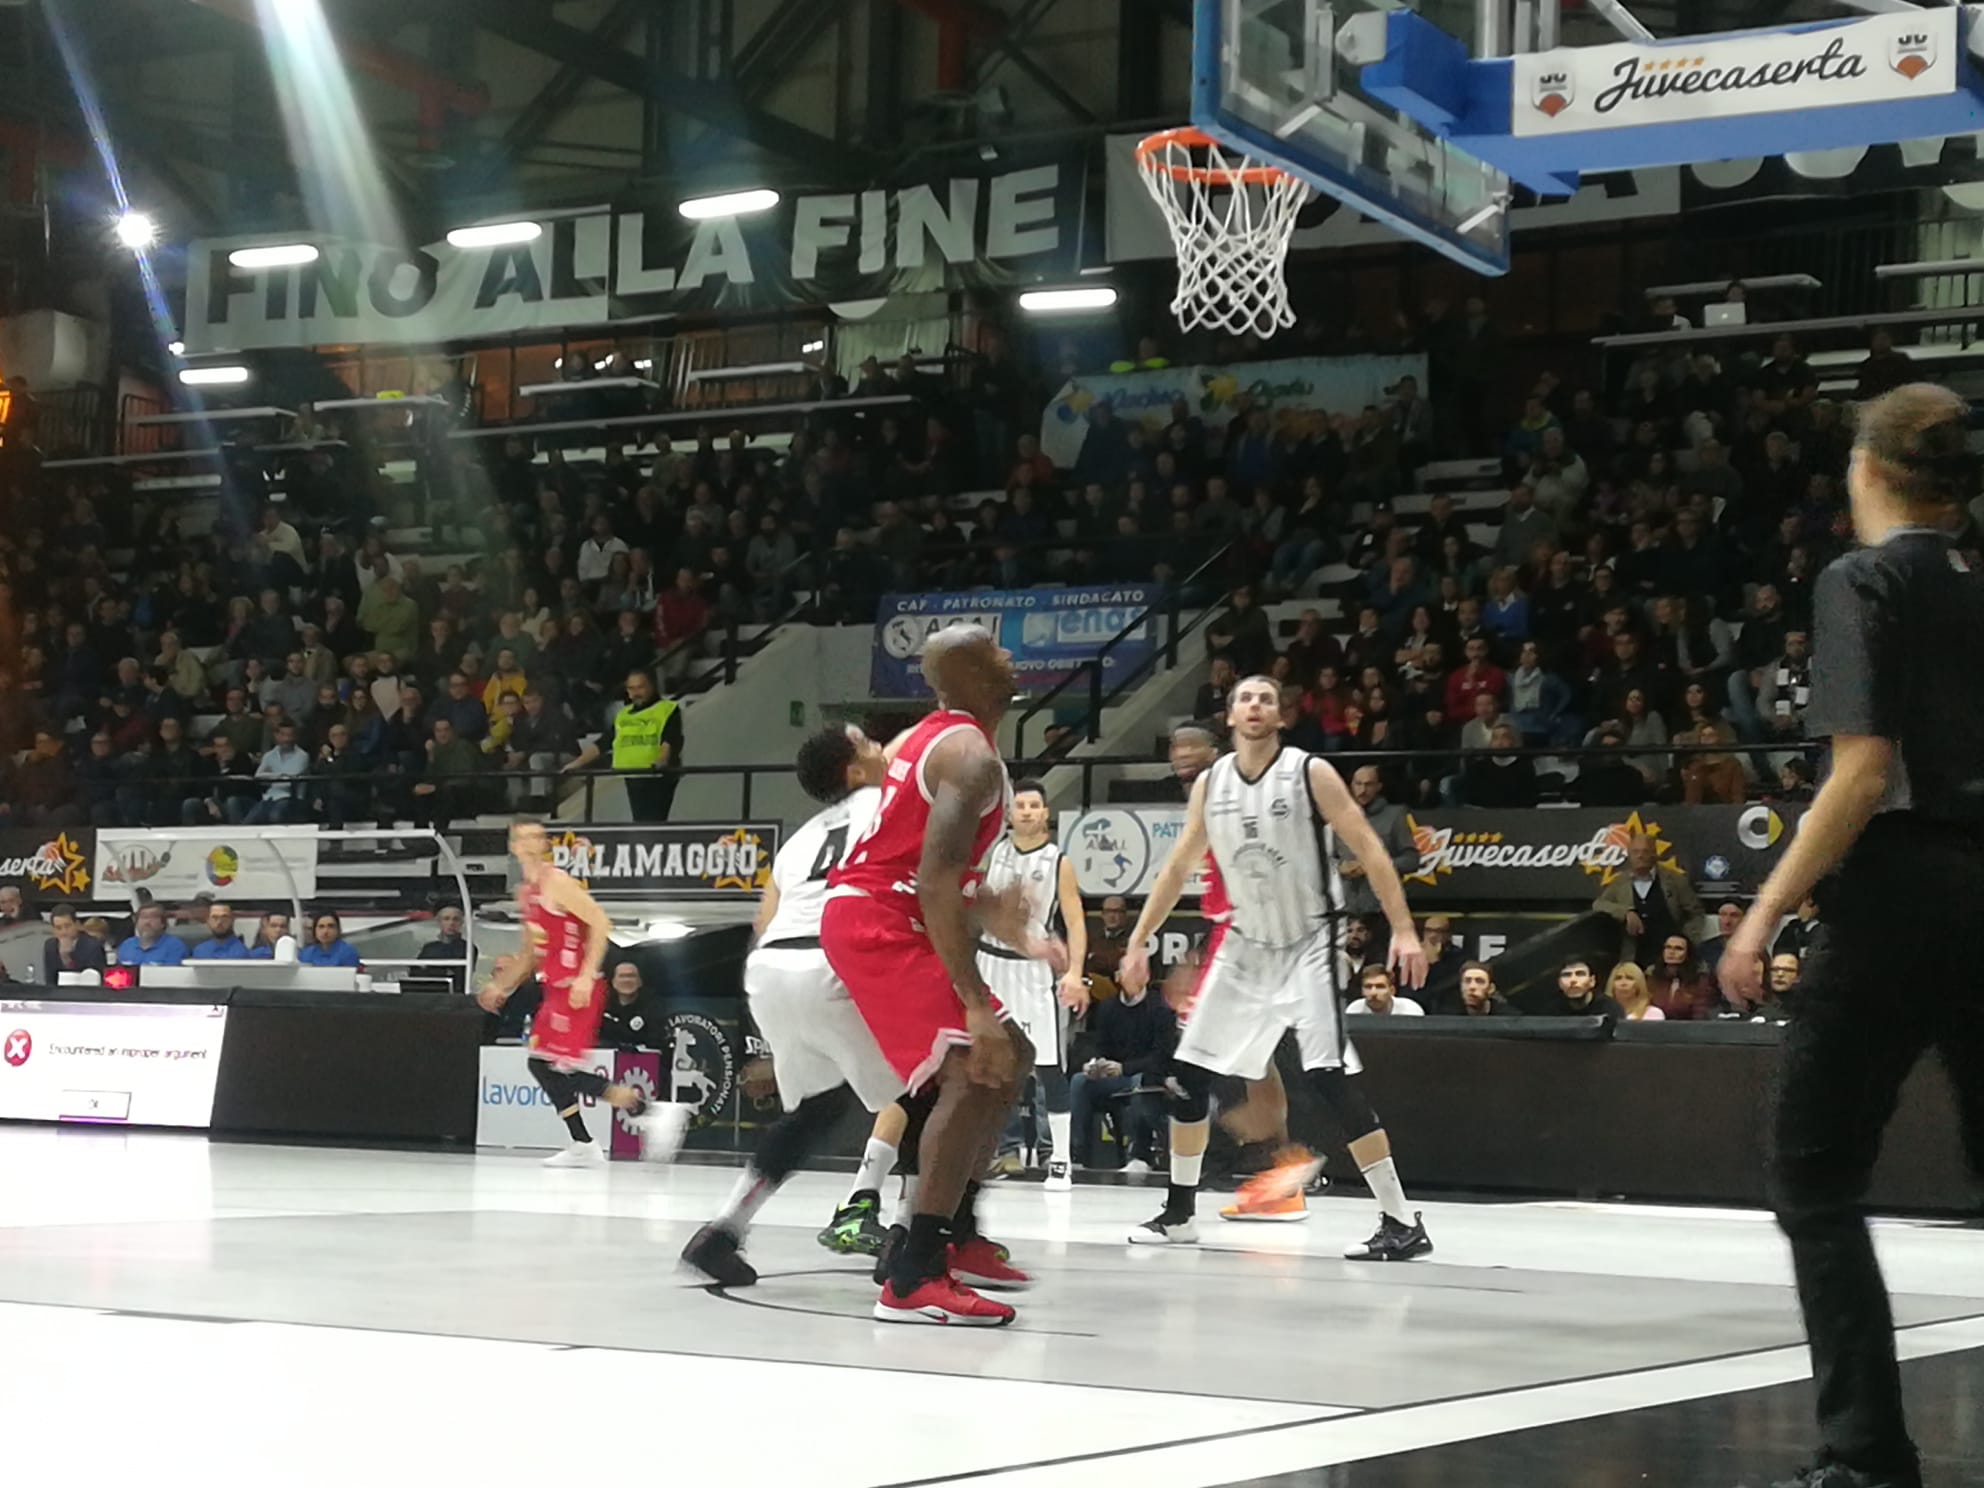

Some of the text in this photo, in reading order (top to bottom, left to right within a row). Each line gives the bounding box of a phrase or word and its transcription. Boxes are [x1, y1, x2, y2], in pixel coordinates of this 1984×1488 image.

[1594, 38, 1866, 113] Juvecaserta
[207, 164, 1059, 324] FINO ALLA FINE
[1053, 589, 1145, 607] SINDACATO
[1418, 827, 1629, 877] Juvecaserta
